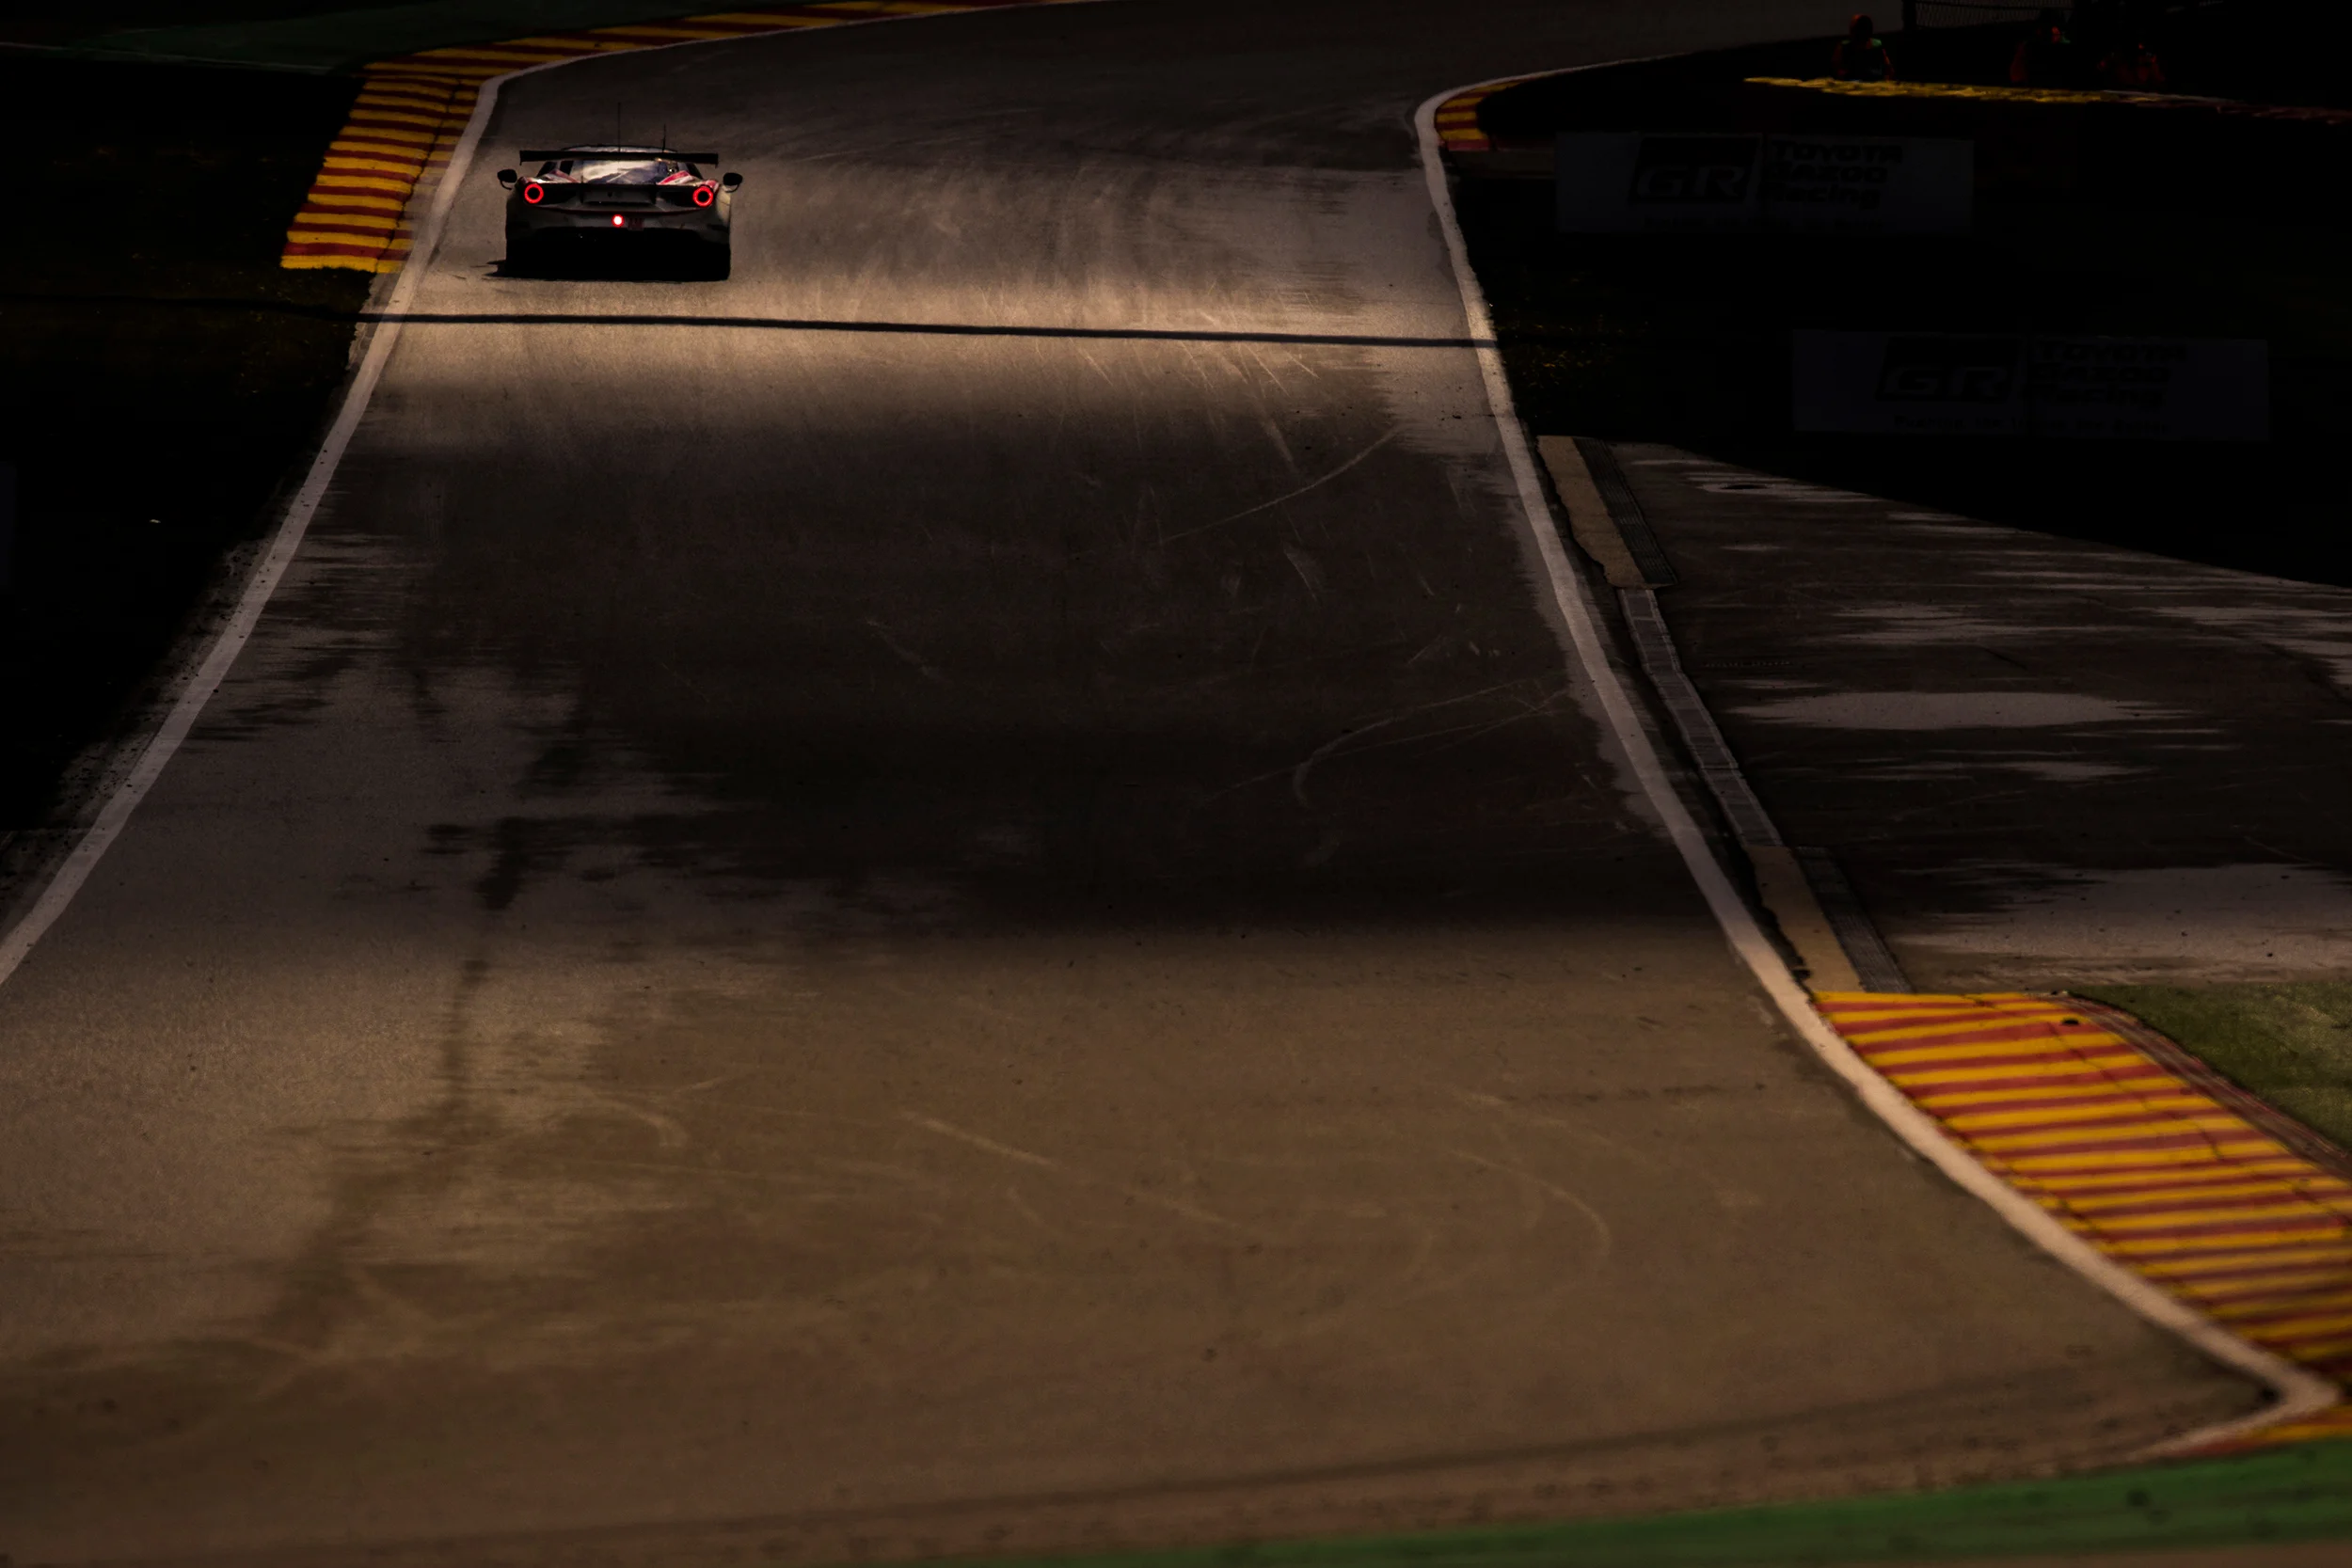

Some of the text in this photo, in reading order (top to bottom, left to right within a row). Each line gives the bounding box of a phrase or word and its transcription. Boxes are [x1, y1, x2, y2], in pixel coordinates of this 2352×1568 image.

[1770, 141, 1902, 164] TOYOTA
[1637, 166, 1745, 198] GR
[2035, 340, 2187, 362] TOYOTA
[1883, 367, 2007, 397] GR
